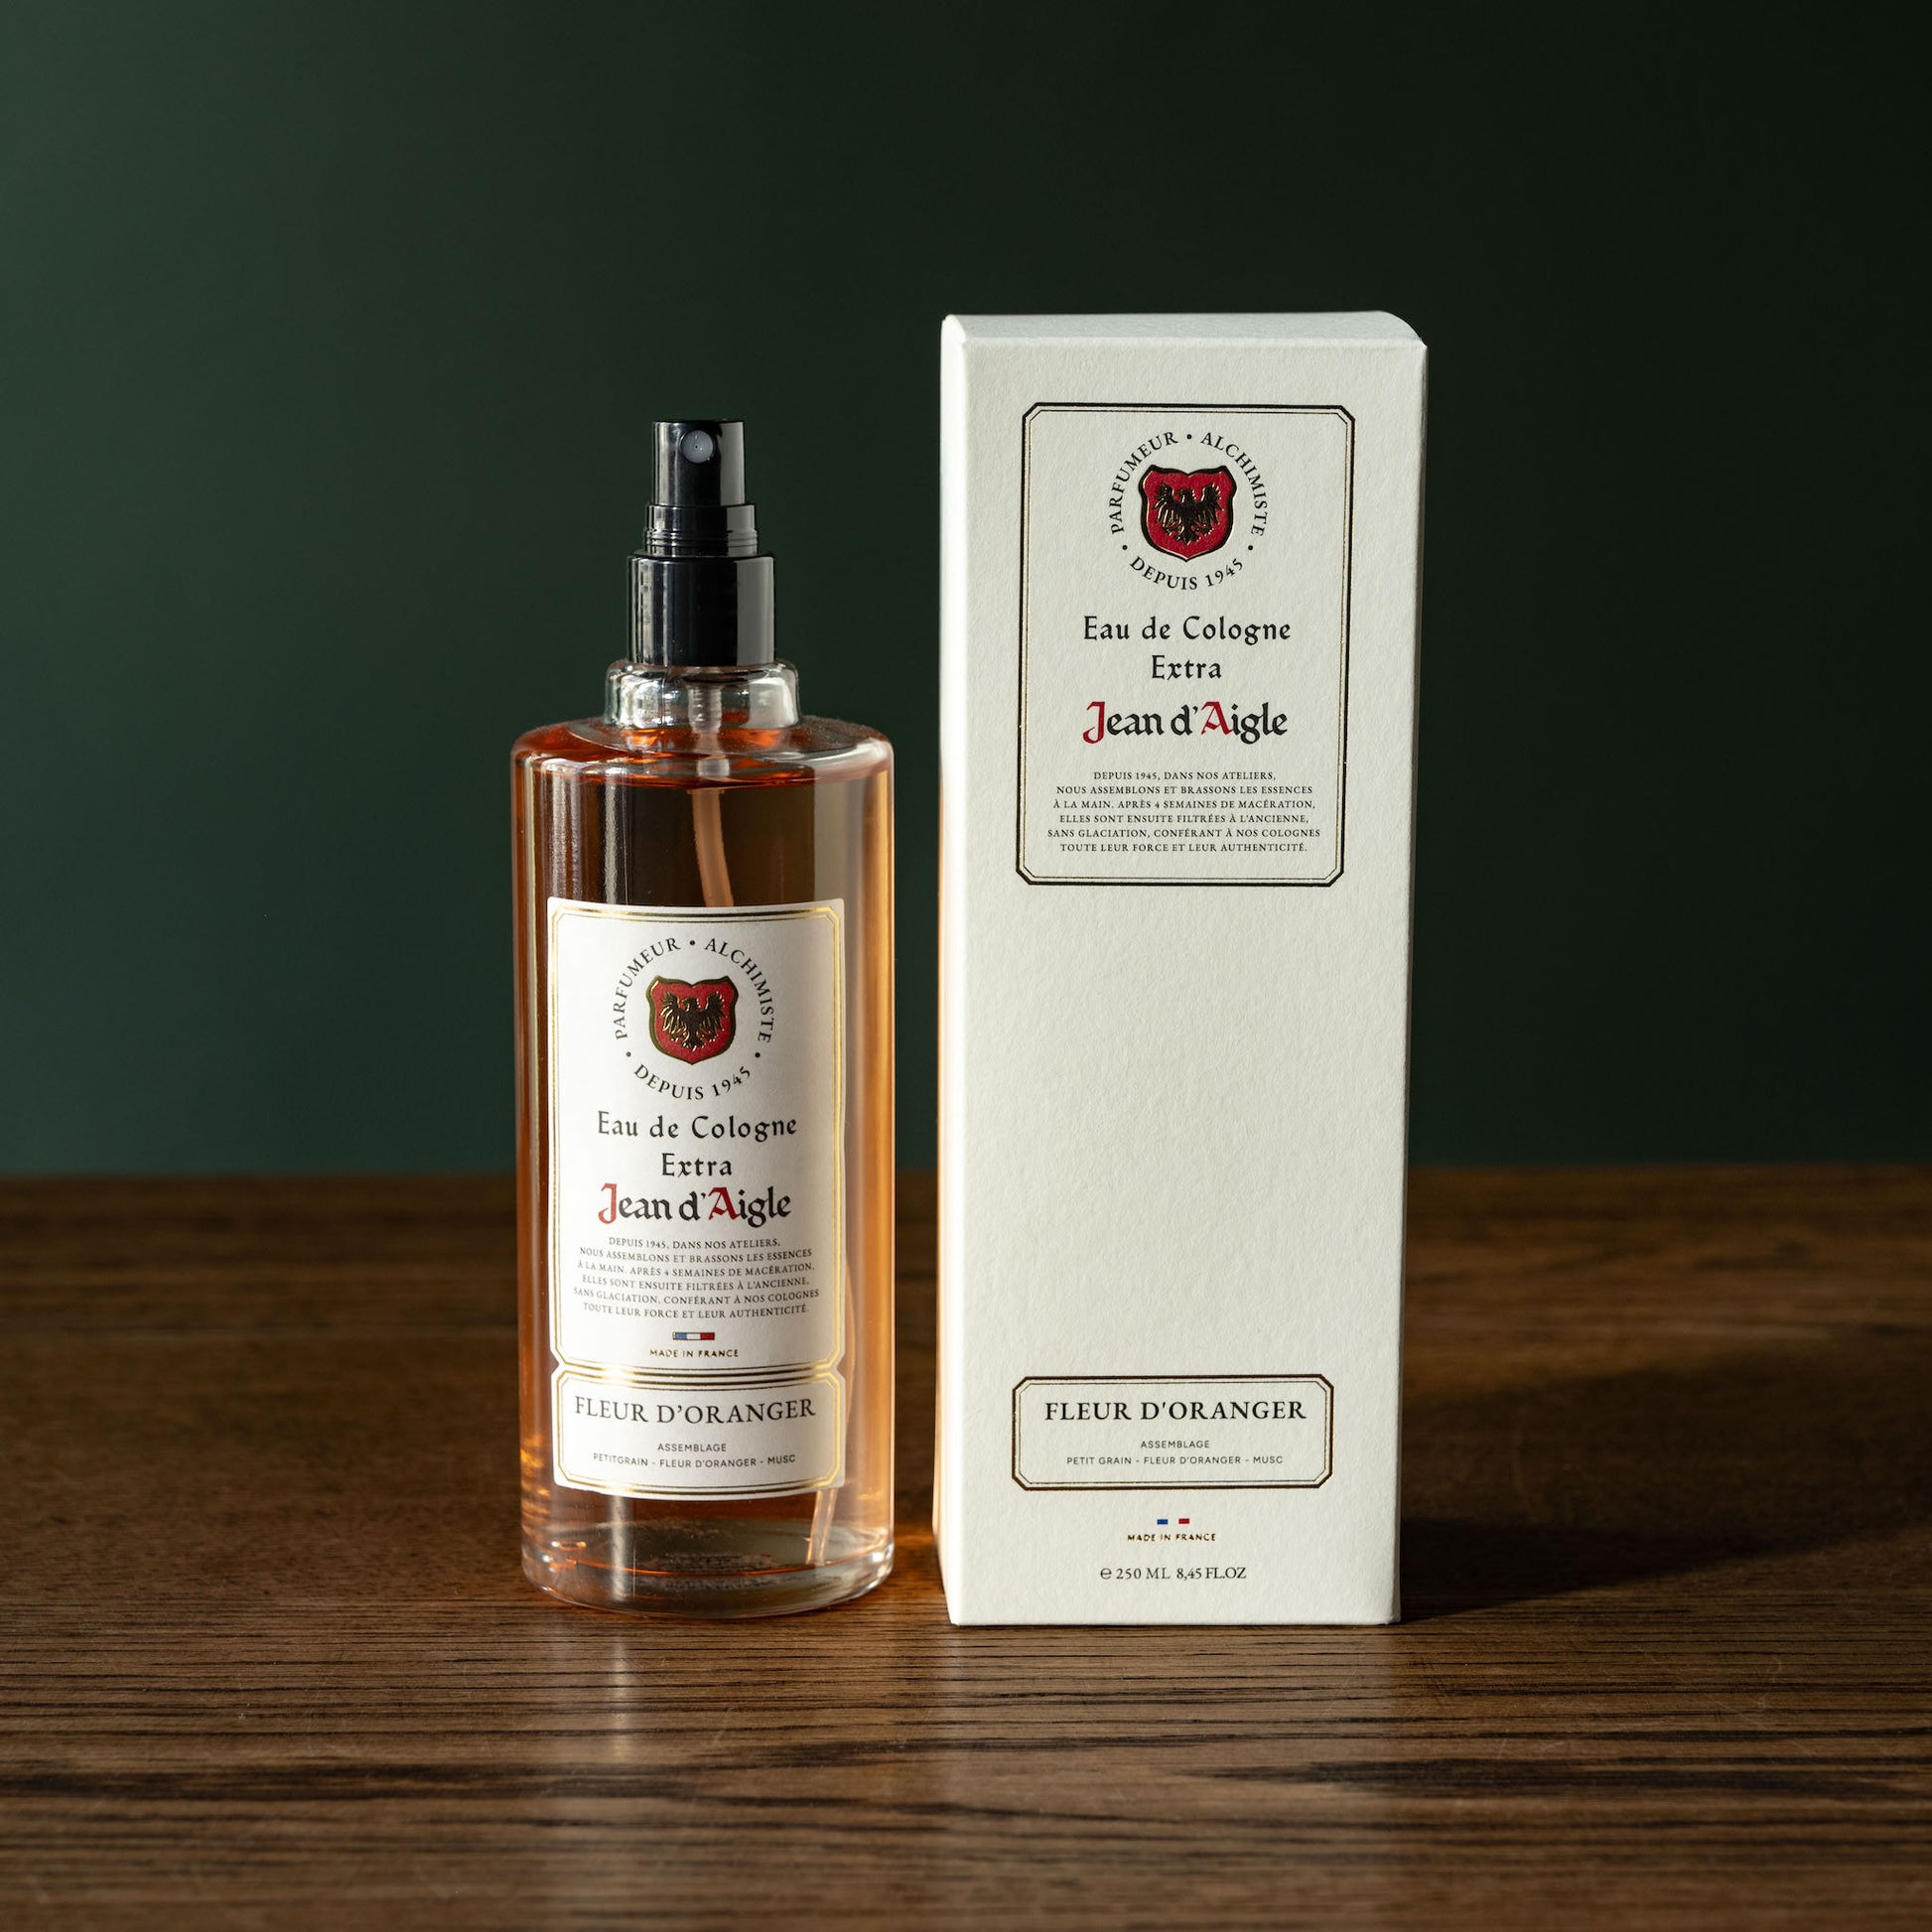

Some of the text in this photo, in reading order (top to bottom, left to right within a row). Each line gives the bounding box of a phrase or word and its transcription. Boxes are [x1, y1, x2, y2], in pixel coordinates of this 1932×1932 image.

[1109, 432, 1268, 536] PARFUMEUR ALCHIMISTE
[1130, 556, 1243, 590] DEPUIS 1945
[1084, 616, 1291, 645] Eau de Cologne
[1152, 655, 1222, 680] Extra
[1083, 701, 1287, 744] Jean d'Aigle
[1136, 771, 1161, 781] 1945,
[1222, 771, 1276, 781] ATELIERS,
[1053, 799, 1060, 808] À
[1118, 799, 1152, 808] APRÈS
[1238, 799, 1315, 810] MACÉRATION,
[1176, 814, 1225, 823] FILTRÉES
[1229, 813, 1236, 823] À
[1240, 815, 1309, 824] L'ANCIENNE,
[1078, 829, 1151, 838] GLACIATION,
[1155, 828, 1222, 837] CONFÉRANT
[1225, 828, 1232, 837] À
[1220, 842, 1308, 852] AUTHENTICITÉ.
[613, 937, 774, 1043] PARFUMEUR ALCHIMISTE
[634, 1064, 751, 1100] DEPUIS 1945
[598, 1110, 797, 1142] Eau de Cologne
[662, 1153, 732, 1177] Extra
[598, 1182, 791, 1228] Jean d'Aigle
[609, 1237, 643, 1248] DEPUIS
[580, 1247, 604, 1258] NOUS
[606, 1250, 669, 1263] ASSEMBLONS
[690, 1254, 744, 1263] BRASSONS
[747, 1253, 763, 1262] LES
[767, 1249, 812, 1260] ESSENCES
[585, 1262, 596, 1271] LA
[630, 1266, 661, 1276] APRÈS
[583, 1275, 608, 1286] ELLES
[610, 1279, 635, 1289] SONT
[638, 1282, 683, 1291] ENSUITE
[686, 1280, 734, 1291] FILTRÉES
[738, 1280, 744, 1290] À
[574, 1287, 594, 1298] SANS
[664, 1295, 730, 1305] CONFÉRANT
[734, 1295, 741, 1304] À
[768, 1289, 819, 1302] COLOGNES
[584, 1303, 613, 1313] TOUTE
[616, 1307, 641, 1316] LEUR
[644, 1310, 678, 1318] FORCE
[575, 1396, 816, 1424] FLEUR D'ORANGER
[1044, 1401, 1307, 1421] FLEUR D'ORANGER
[695, 1458, 757, 1467] D'ORANGER
[767, 1454, 796, 1465] MUSC
[1116, 1568, 1141, 1580] 250
[1146, 1568, 1171, 1579] ML
[1176, 1568, 1201, 1581] 8,45
[1205, 1567, 1246, 1579] FL.OZ
